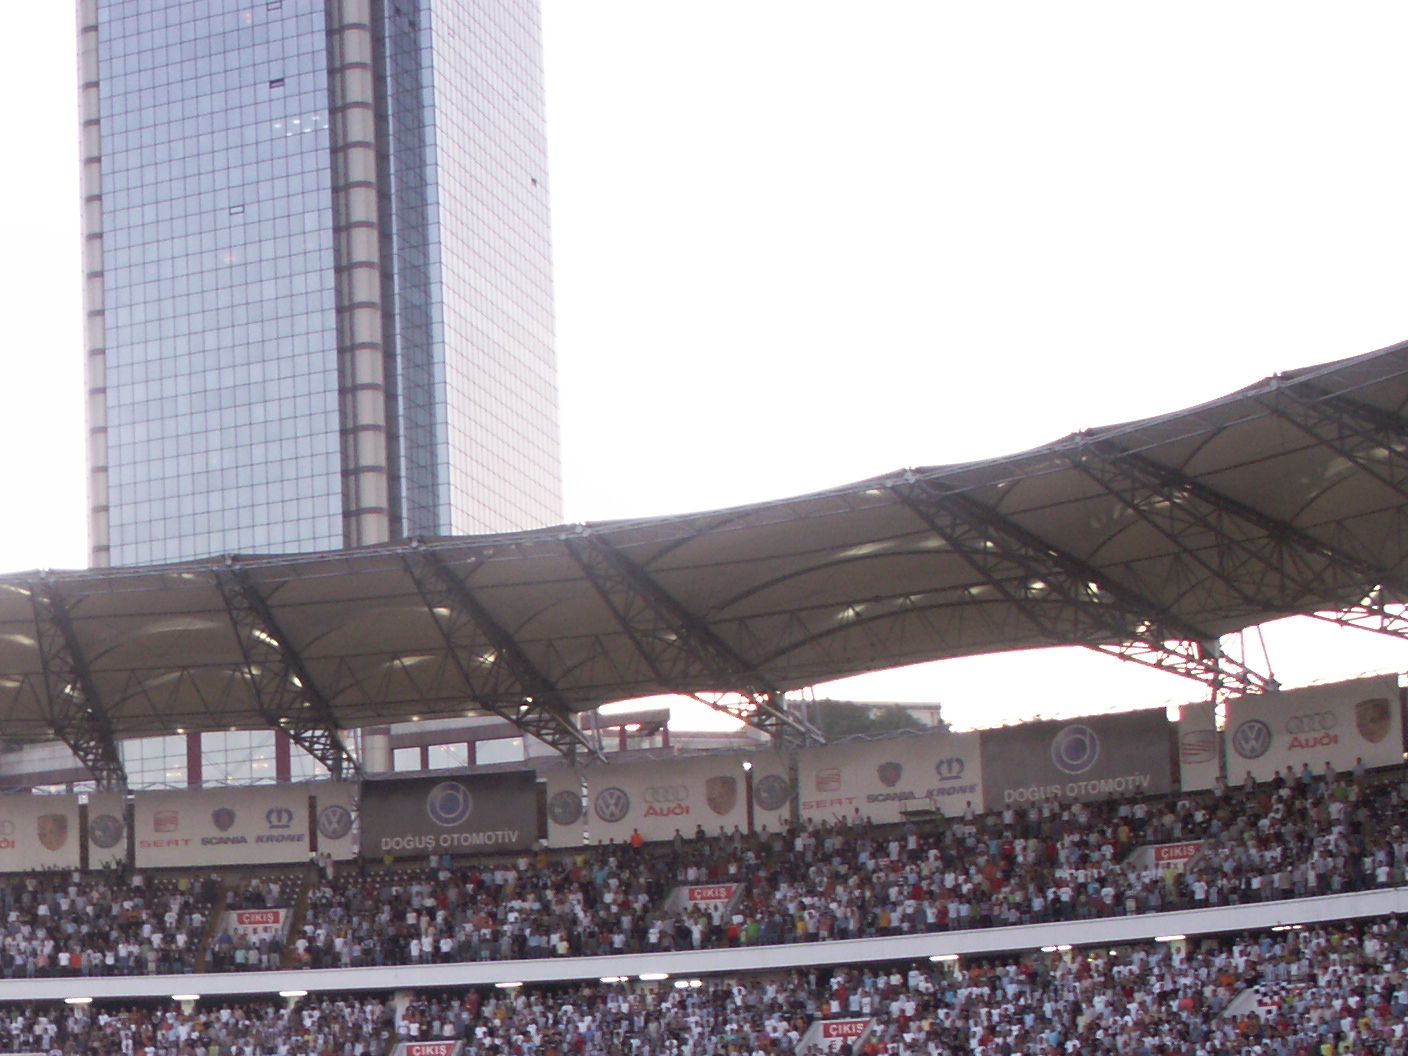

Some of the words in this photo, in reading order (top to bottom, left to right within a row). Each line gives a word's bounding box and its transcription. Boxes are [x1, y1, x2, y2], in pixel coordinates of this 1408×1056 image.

[866, 791, 916, 803] SCANIA
[925, 783, 978, 799] KRONE
[802, 797, 856, 810] SEAT
[139, 838, 191, 848] SEAT
[201, 835, 248, 846] SCANIA
[255, 833, 305, 844] KRONE
[439, 828, 519, 847] OTOMOTİV
